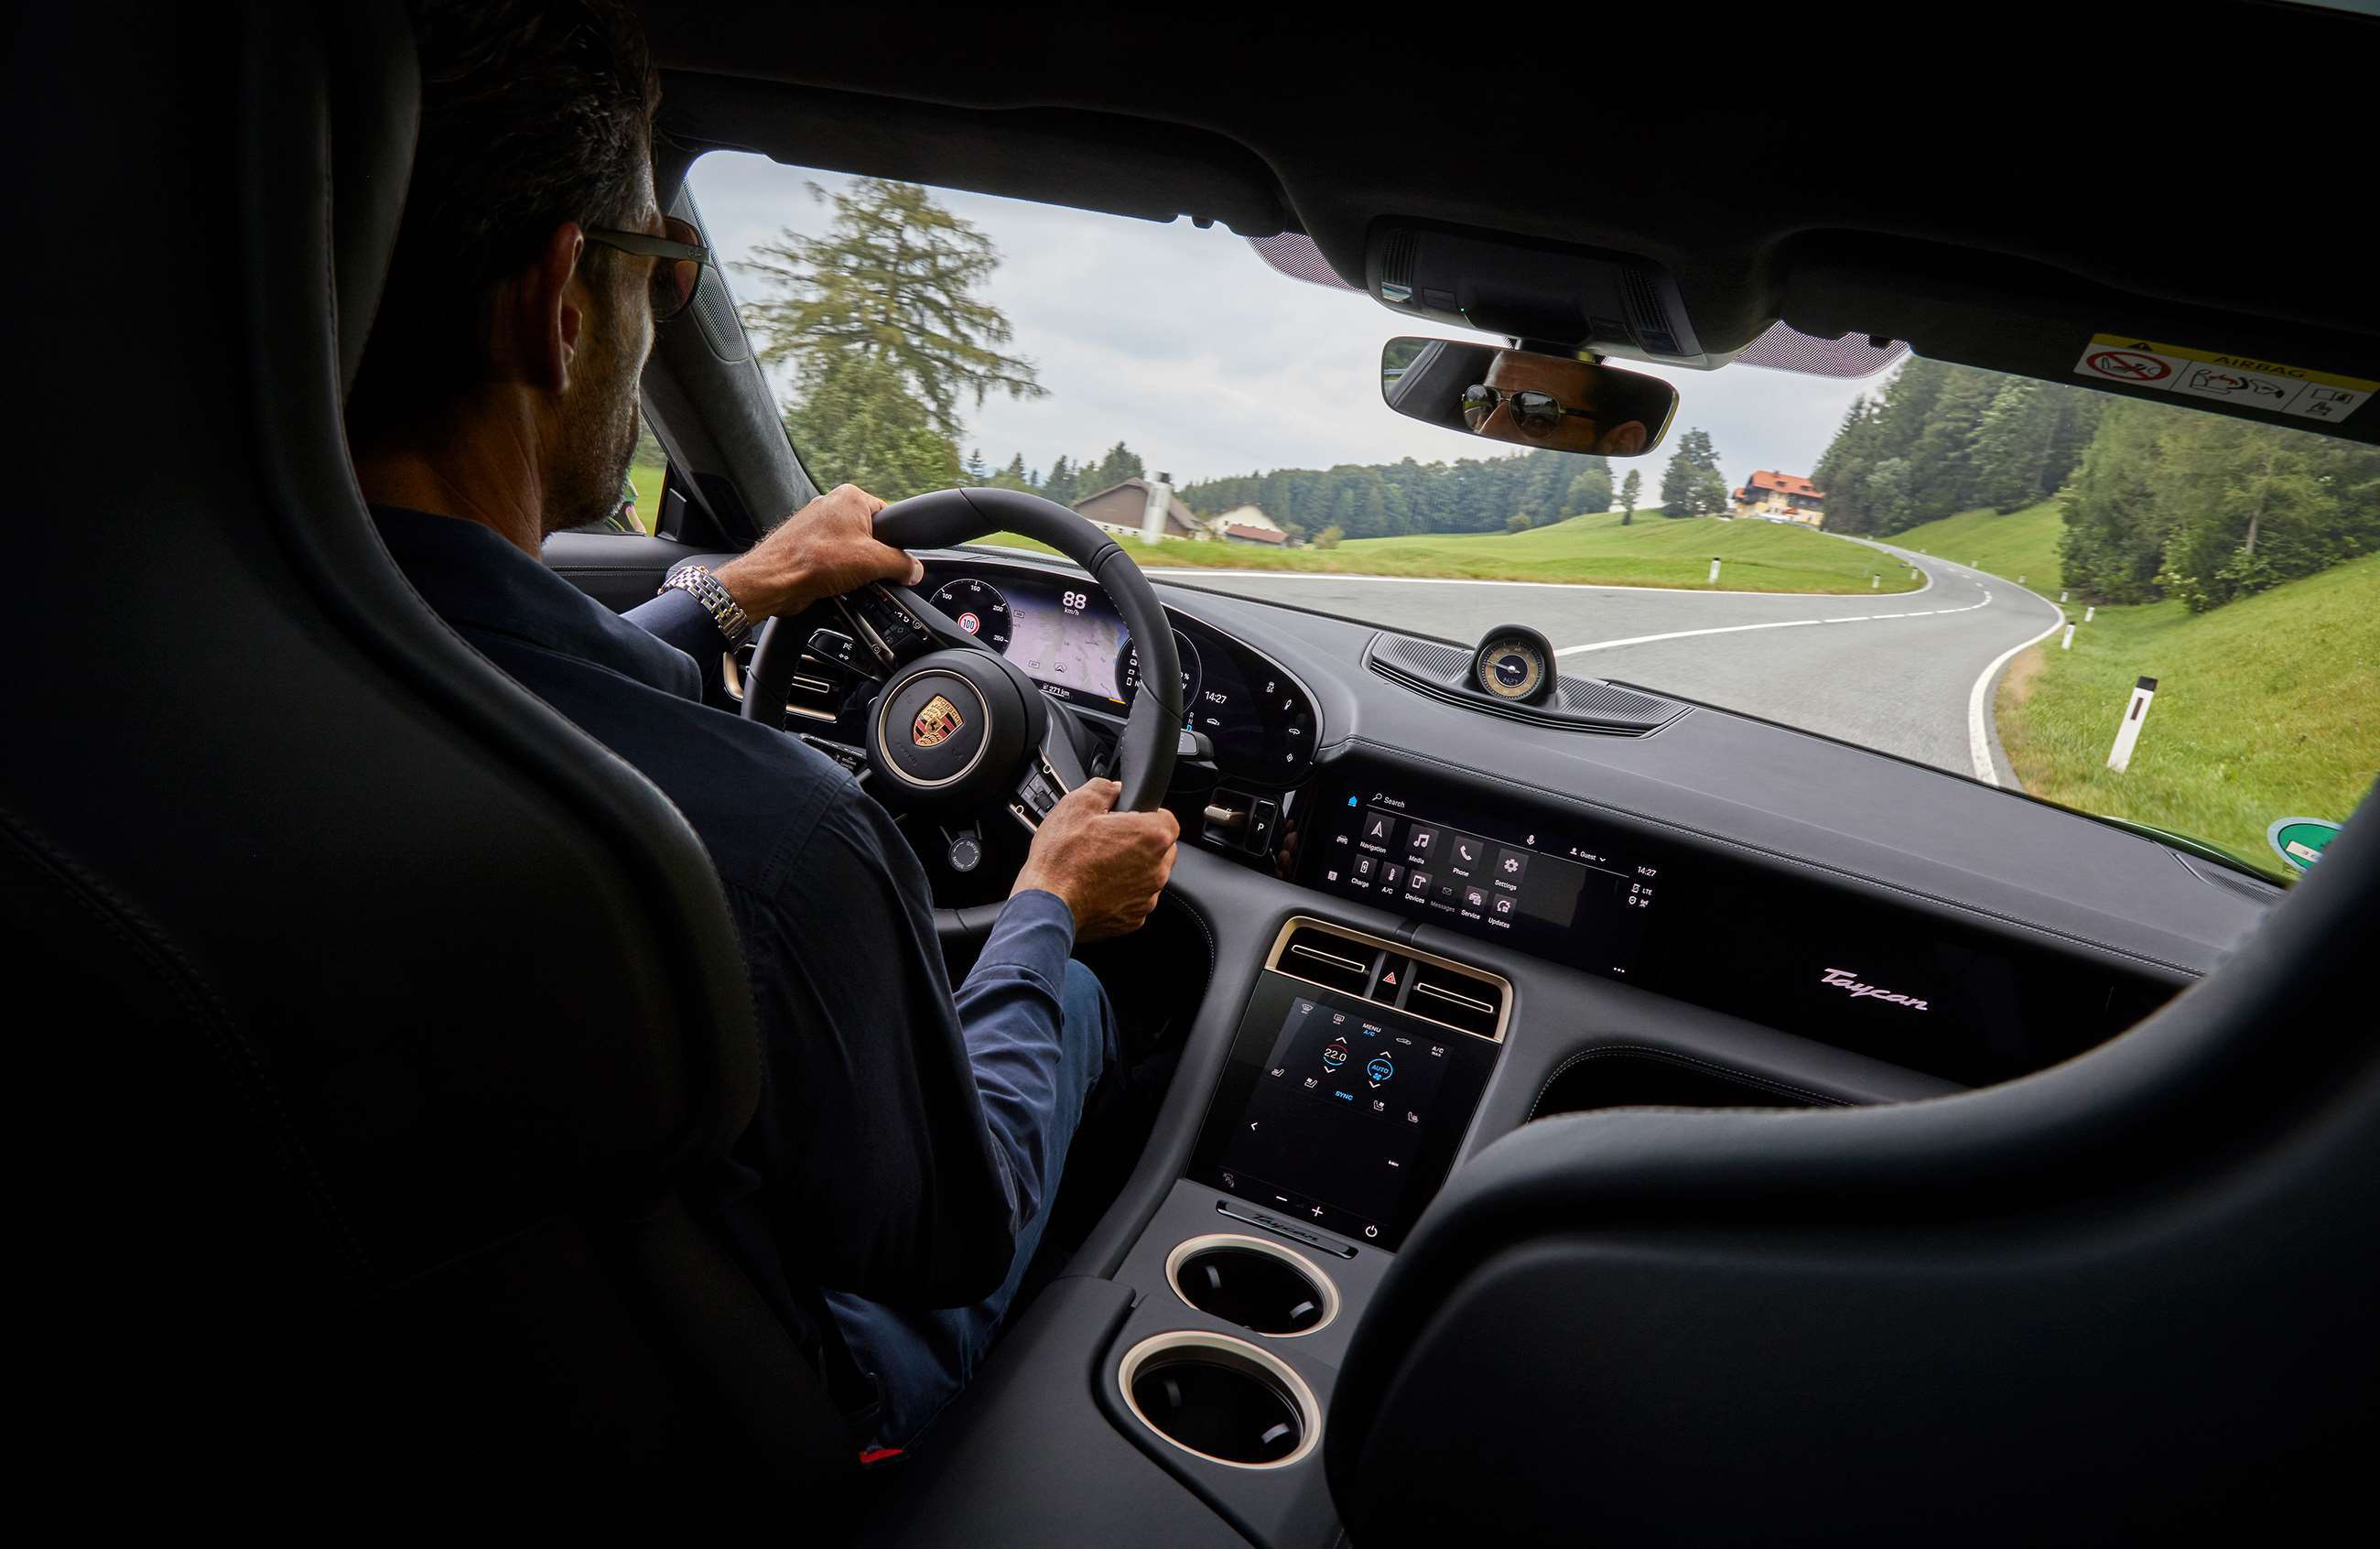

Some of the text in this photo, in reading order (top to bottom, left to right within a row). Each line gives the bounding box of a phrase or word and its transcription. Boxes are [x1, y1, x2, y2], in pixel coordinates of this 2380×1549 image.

[2213, 356, 2308, 378] AIRBAG
[1063, 590, 1087, 609] 88
[992, 604, 1003, 612] 200
[1064, 607, 1080, 616] km/h
[963, 618, 975, 629] 100
[1048, 685, 1070, 697] 271 km
[1205, 691, 1227, 704] 14:27
[937, 698, 961, 725] PORSCHE
[1383, 796, 1405, 807] Search
[1257, 822, 1265, 830] P
[1359, 841, 1387, 853] Navigation
[1408, 855, 1425, 864] Media
[1580, 850, 1596, 861] Guest
[1453, 867, 1469, 877] Phone
[1638, 866, 1657, 877] 14:27
[1351, 878, 1369, 888] Charge
[1494, 880, 1518, 892] Settings
[1381, 886, 1393, 894] A/C
[1405, 893, 1425, 904] Devices
[1430, 901, 1455, 913] Messages
[1461, 909, 1481, 920] Service
[1488, 917, 1510, 928] Updates
[1821, 968, 1928, 1011] Taycan
[1362, 1023, 1381, 1034] MENU
[1363, 1029, 1376, 1037] A/C
[1324, 1048, 1347, 1062] 22.0
[1432, 1045, 1444, 1054] A/C
[1371, 1064, 1390, 1074] AUTO
[1335, 1090, 1354, 1101] SYNC
